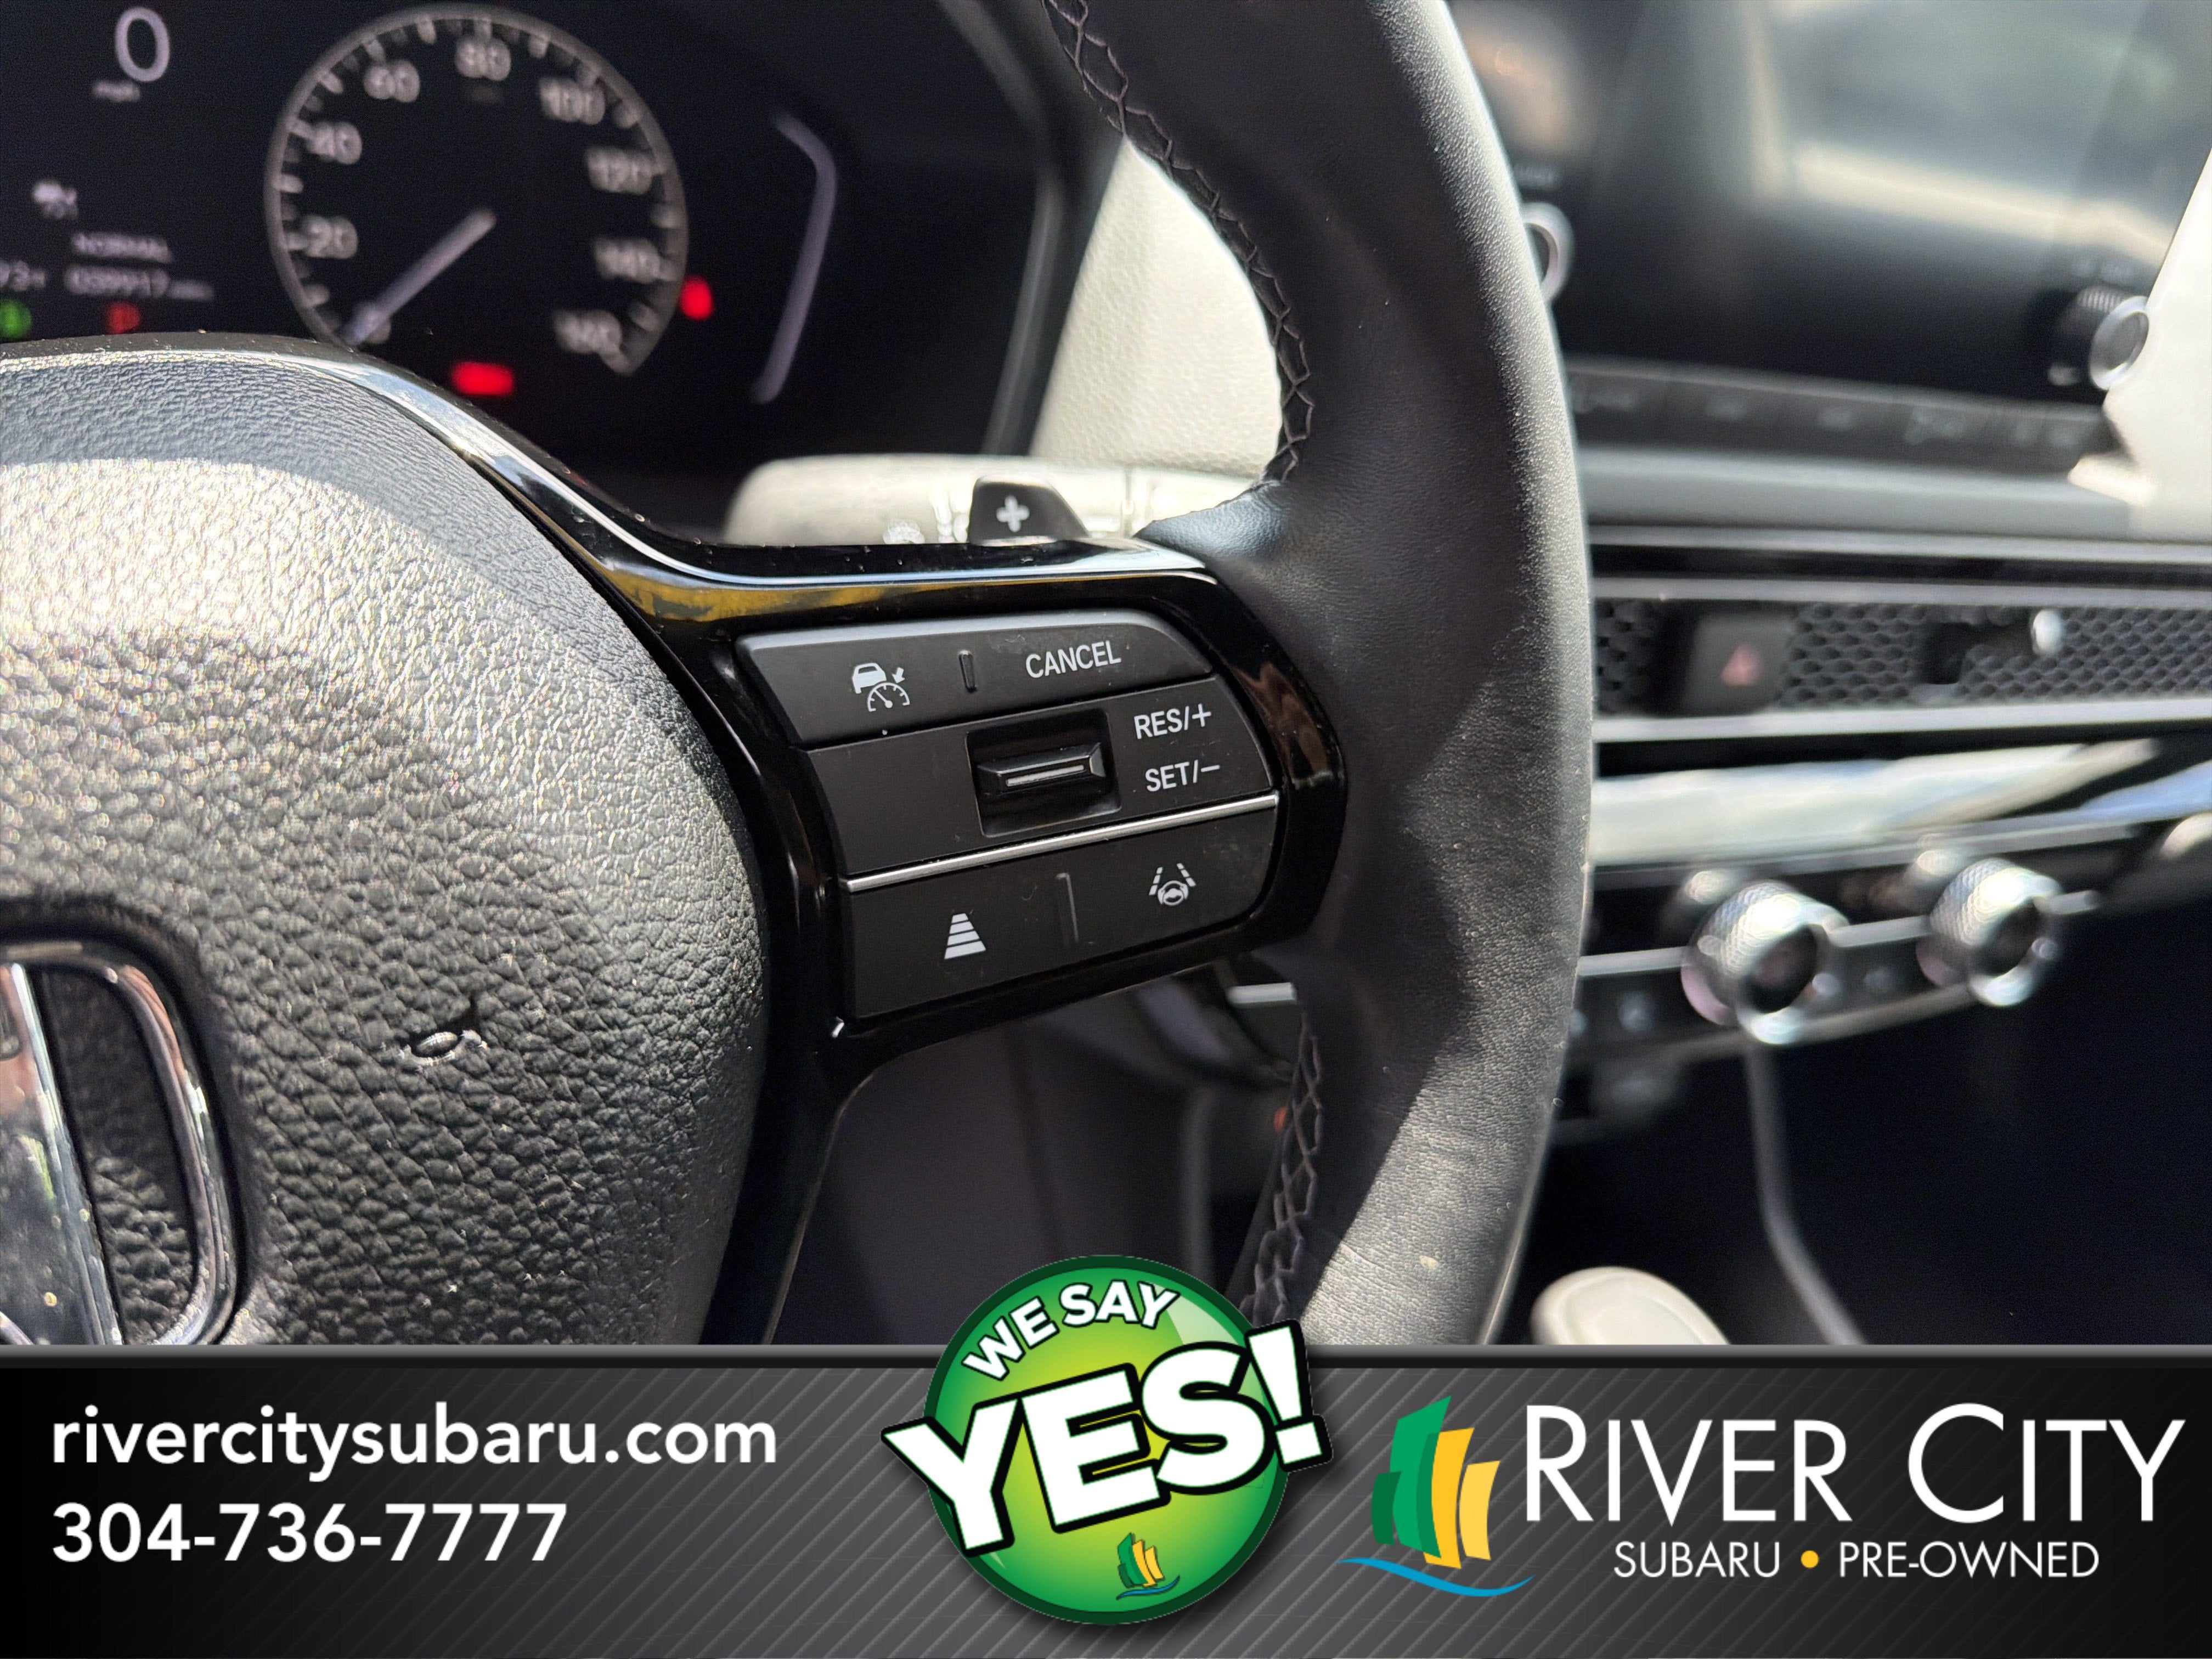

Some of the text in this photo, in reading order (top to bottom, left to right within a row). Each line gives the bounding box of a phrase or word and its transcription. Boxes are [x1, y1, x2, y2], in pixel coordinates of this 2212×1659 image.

[115, 7, 170, 82] 0
[456, 36, 511, 81] 80
[365, 60, 420, 102] 60
[307, 122, 362, 165] 40
[303, 216, 358, 259] 20
[1023, 639, 1121, 679] CANCEL
[1133, 702, 1211, 740] RES/+
